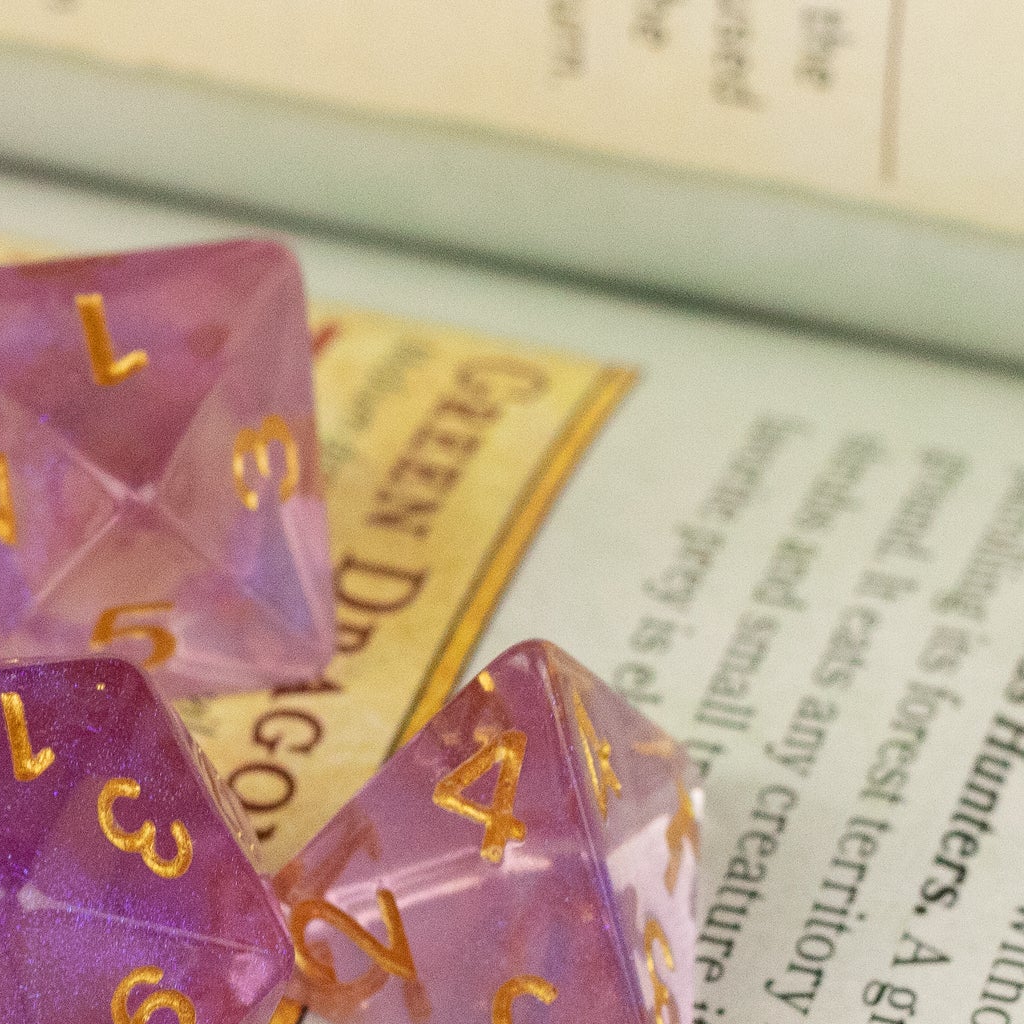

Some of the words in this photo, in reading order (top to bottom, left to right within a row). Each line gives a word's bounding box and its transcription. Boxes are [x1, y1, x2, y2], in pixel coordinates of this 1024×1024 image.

[233, 415, 300, 511] 3
[433, 730, 527, 864] 4
[764, 696, 840, 777] any
[858, 680, 962, 803] forest
[96, 777, 193, 878] 3
[914, 711, 1024, 915] Hunters.
[695, 784, 800, 983] creature
[764, 816, 891, 1016] territory
[893, 932, 952, 968] A
